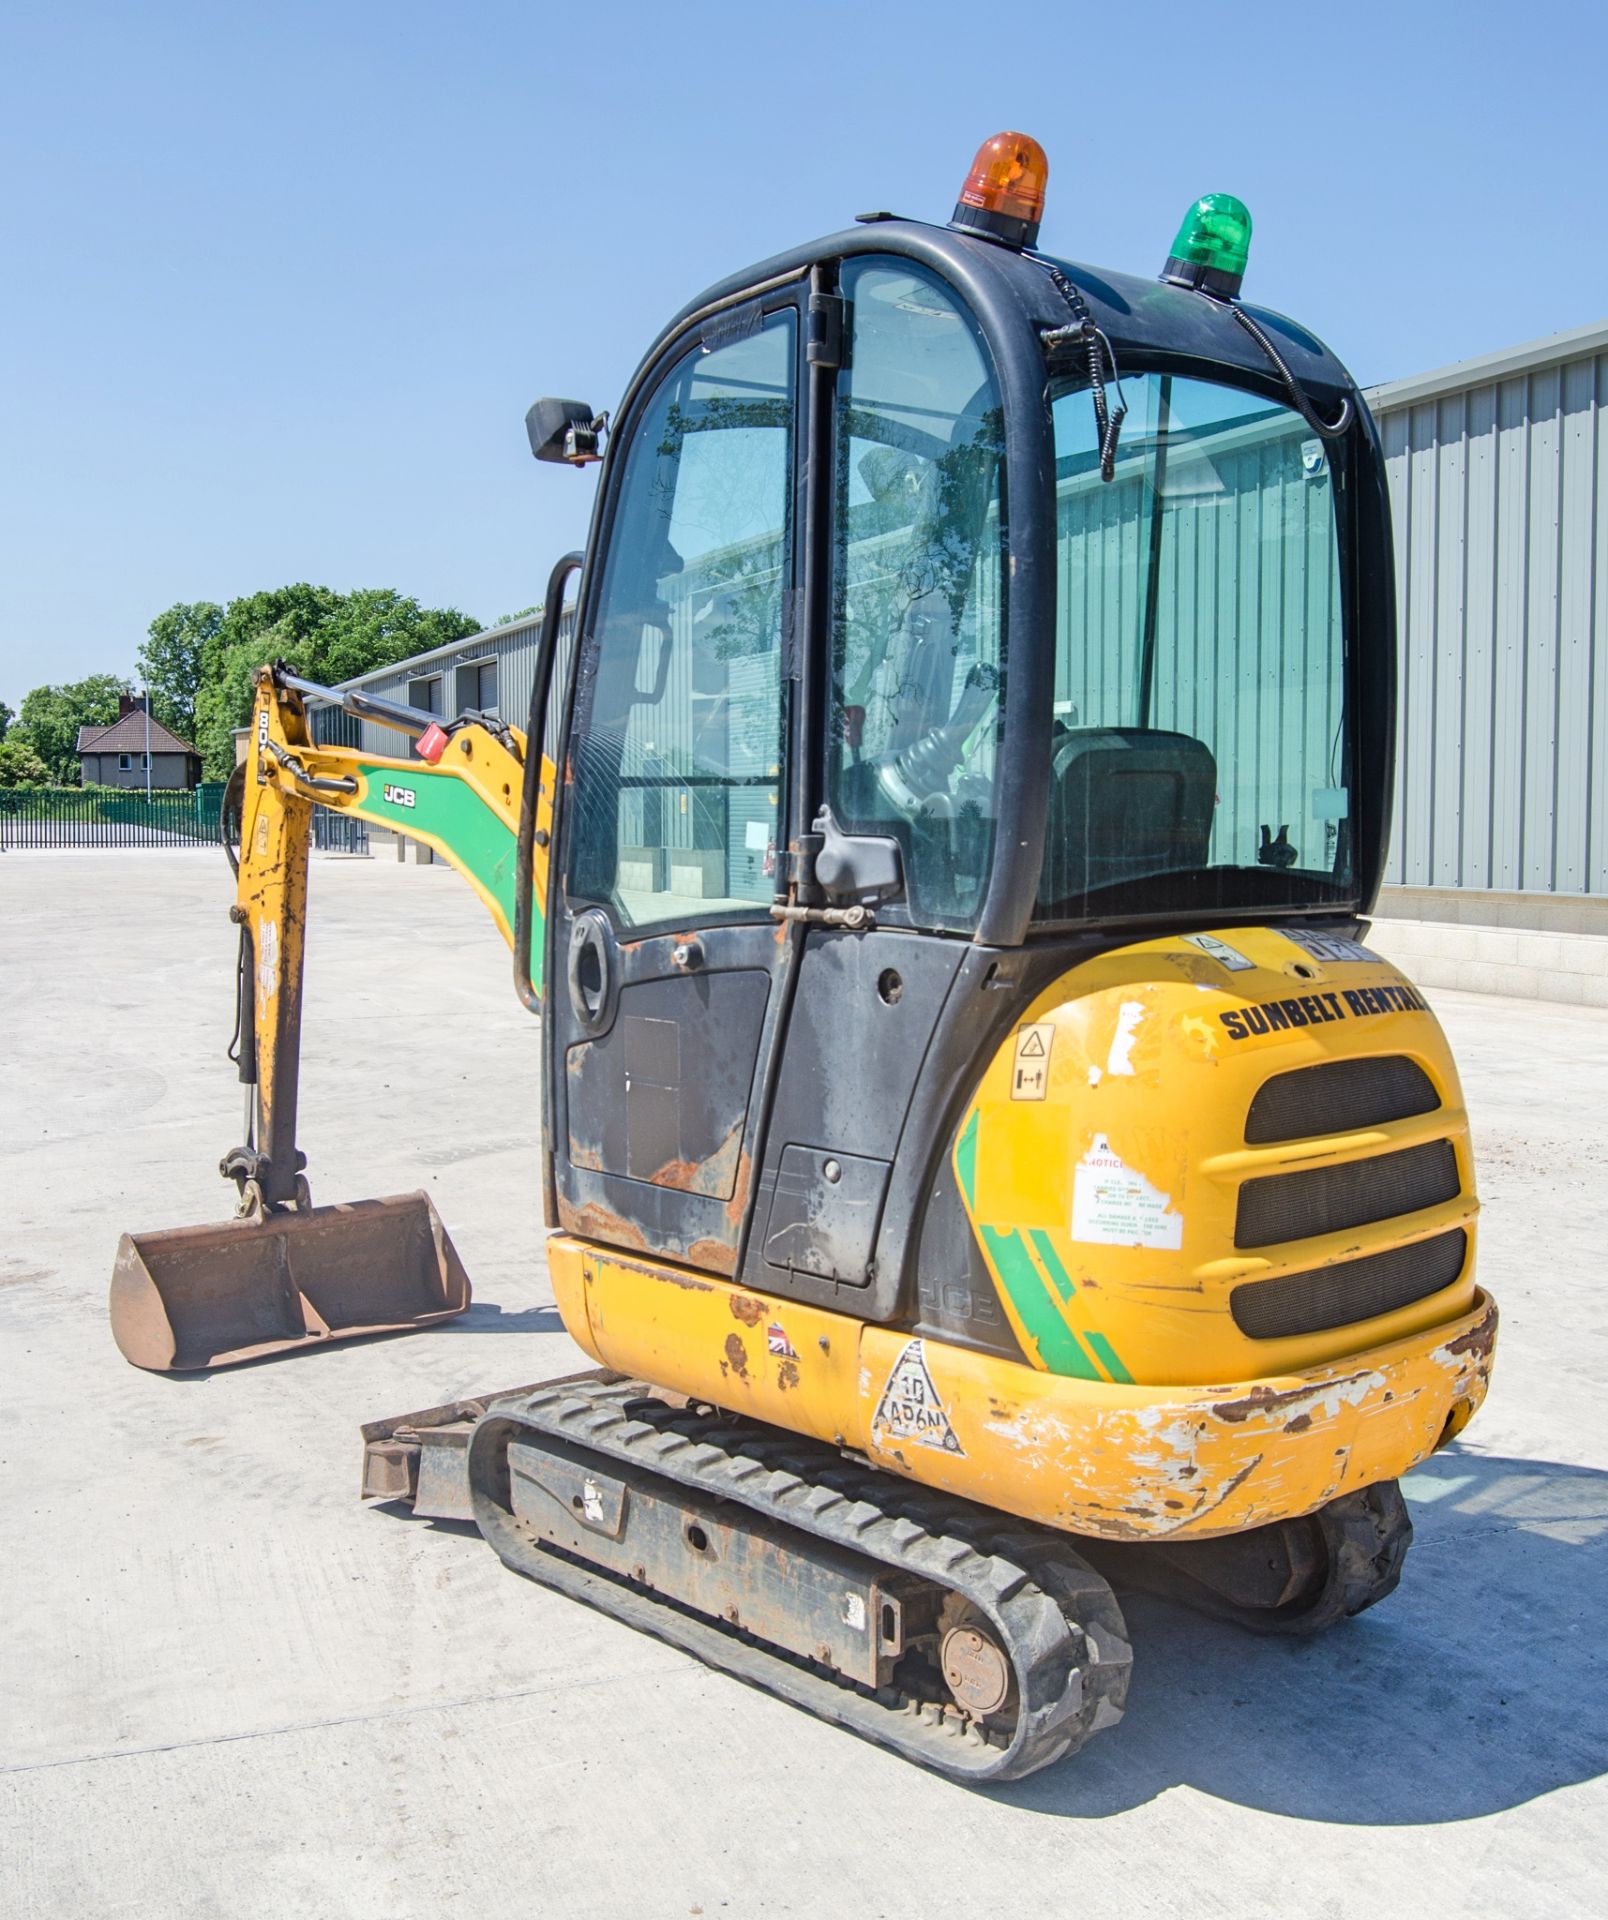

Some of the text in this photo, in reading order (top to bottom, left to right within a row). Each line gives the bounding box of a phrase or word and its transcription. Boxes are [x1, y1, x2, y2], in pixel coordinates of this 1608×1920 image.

[384, 784, 416, 808] JCB
[1219, 992, 1346, 1040] SUNBELT
[920, 1279, 1000, 1326] JCB
